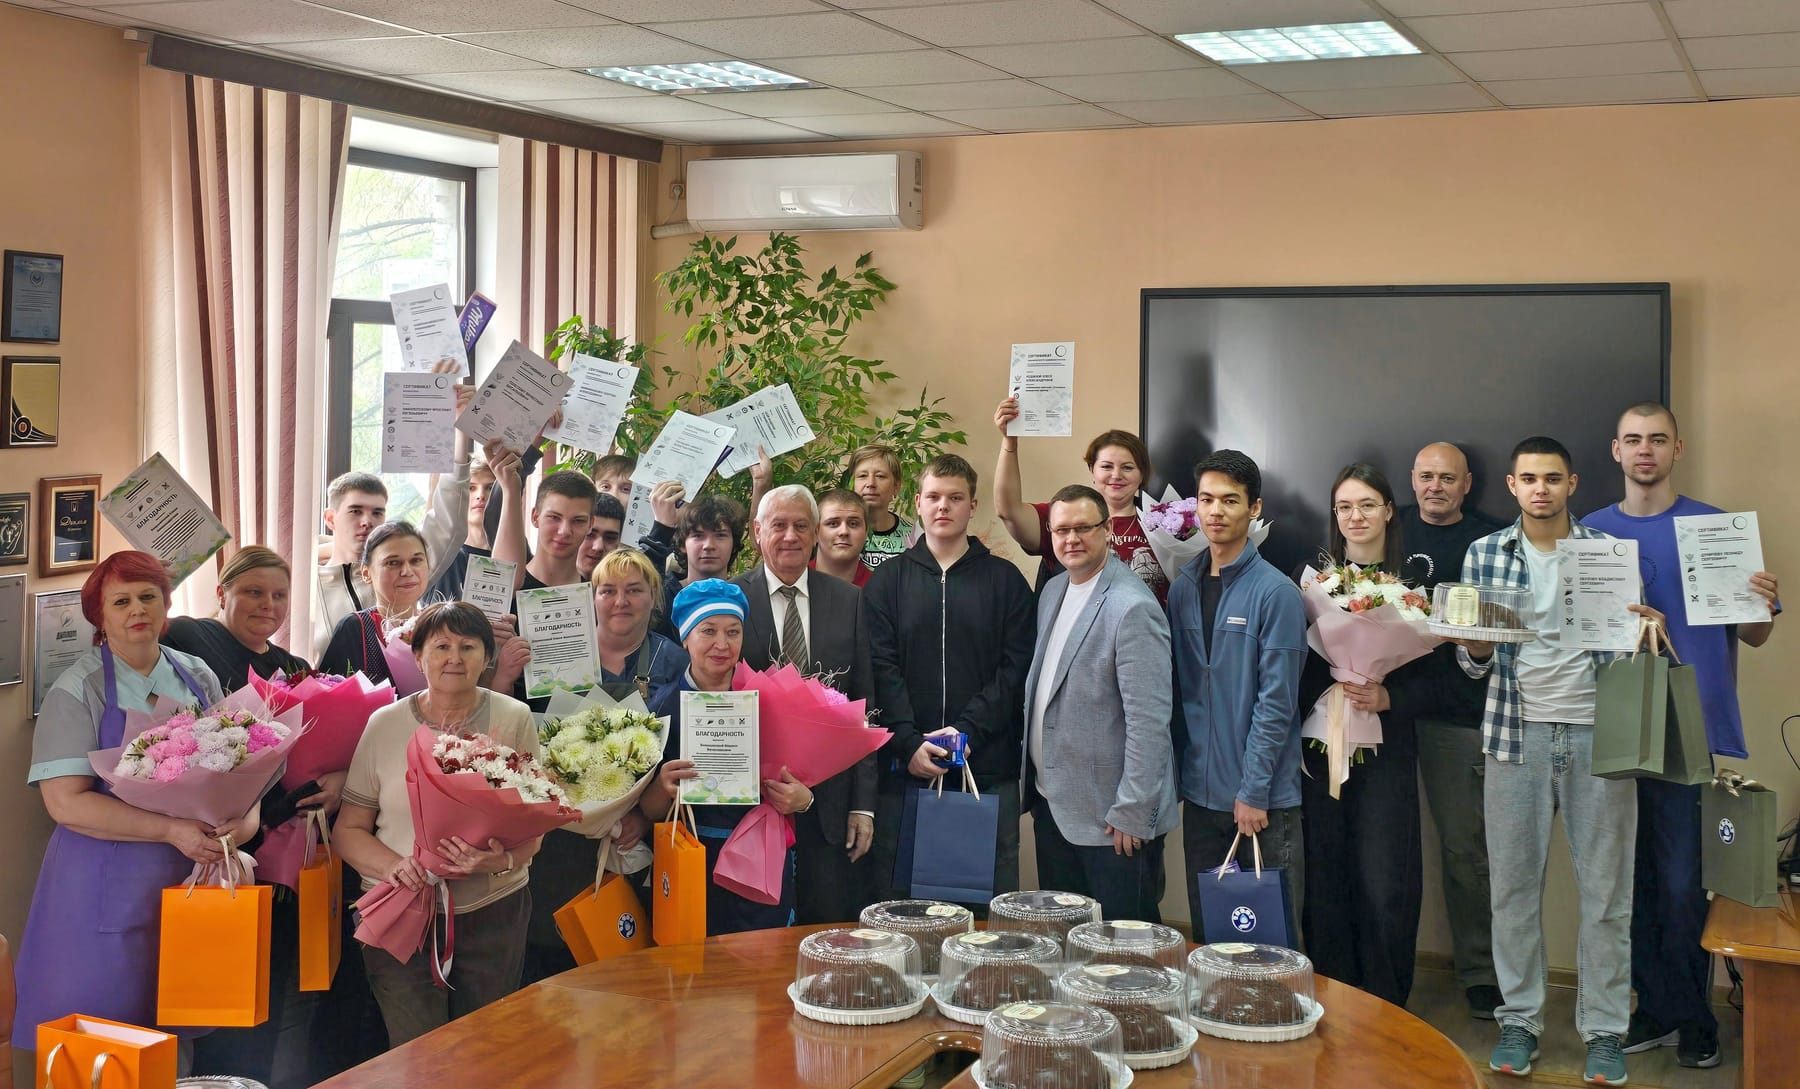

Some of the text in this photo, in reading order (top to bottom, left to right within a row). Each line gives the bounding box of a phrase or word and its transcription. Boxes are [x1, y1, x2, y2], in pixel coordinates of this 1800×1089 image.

[464, 306, 483, 342] Milka
[136, 493, 178, 529] БЛАГОДАРНОСТЬ
[471, 594, 503, 604] БЛАГОДАРНОСТЬ
[534, 622, 582, 633] БЛАГОДАРНОСТЬ
